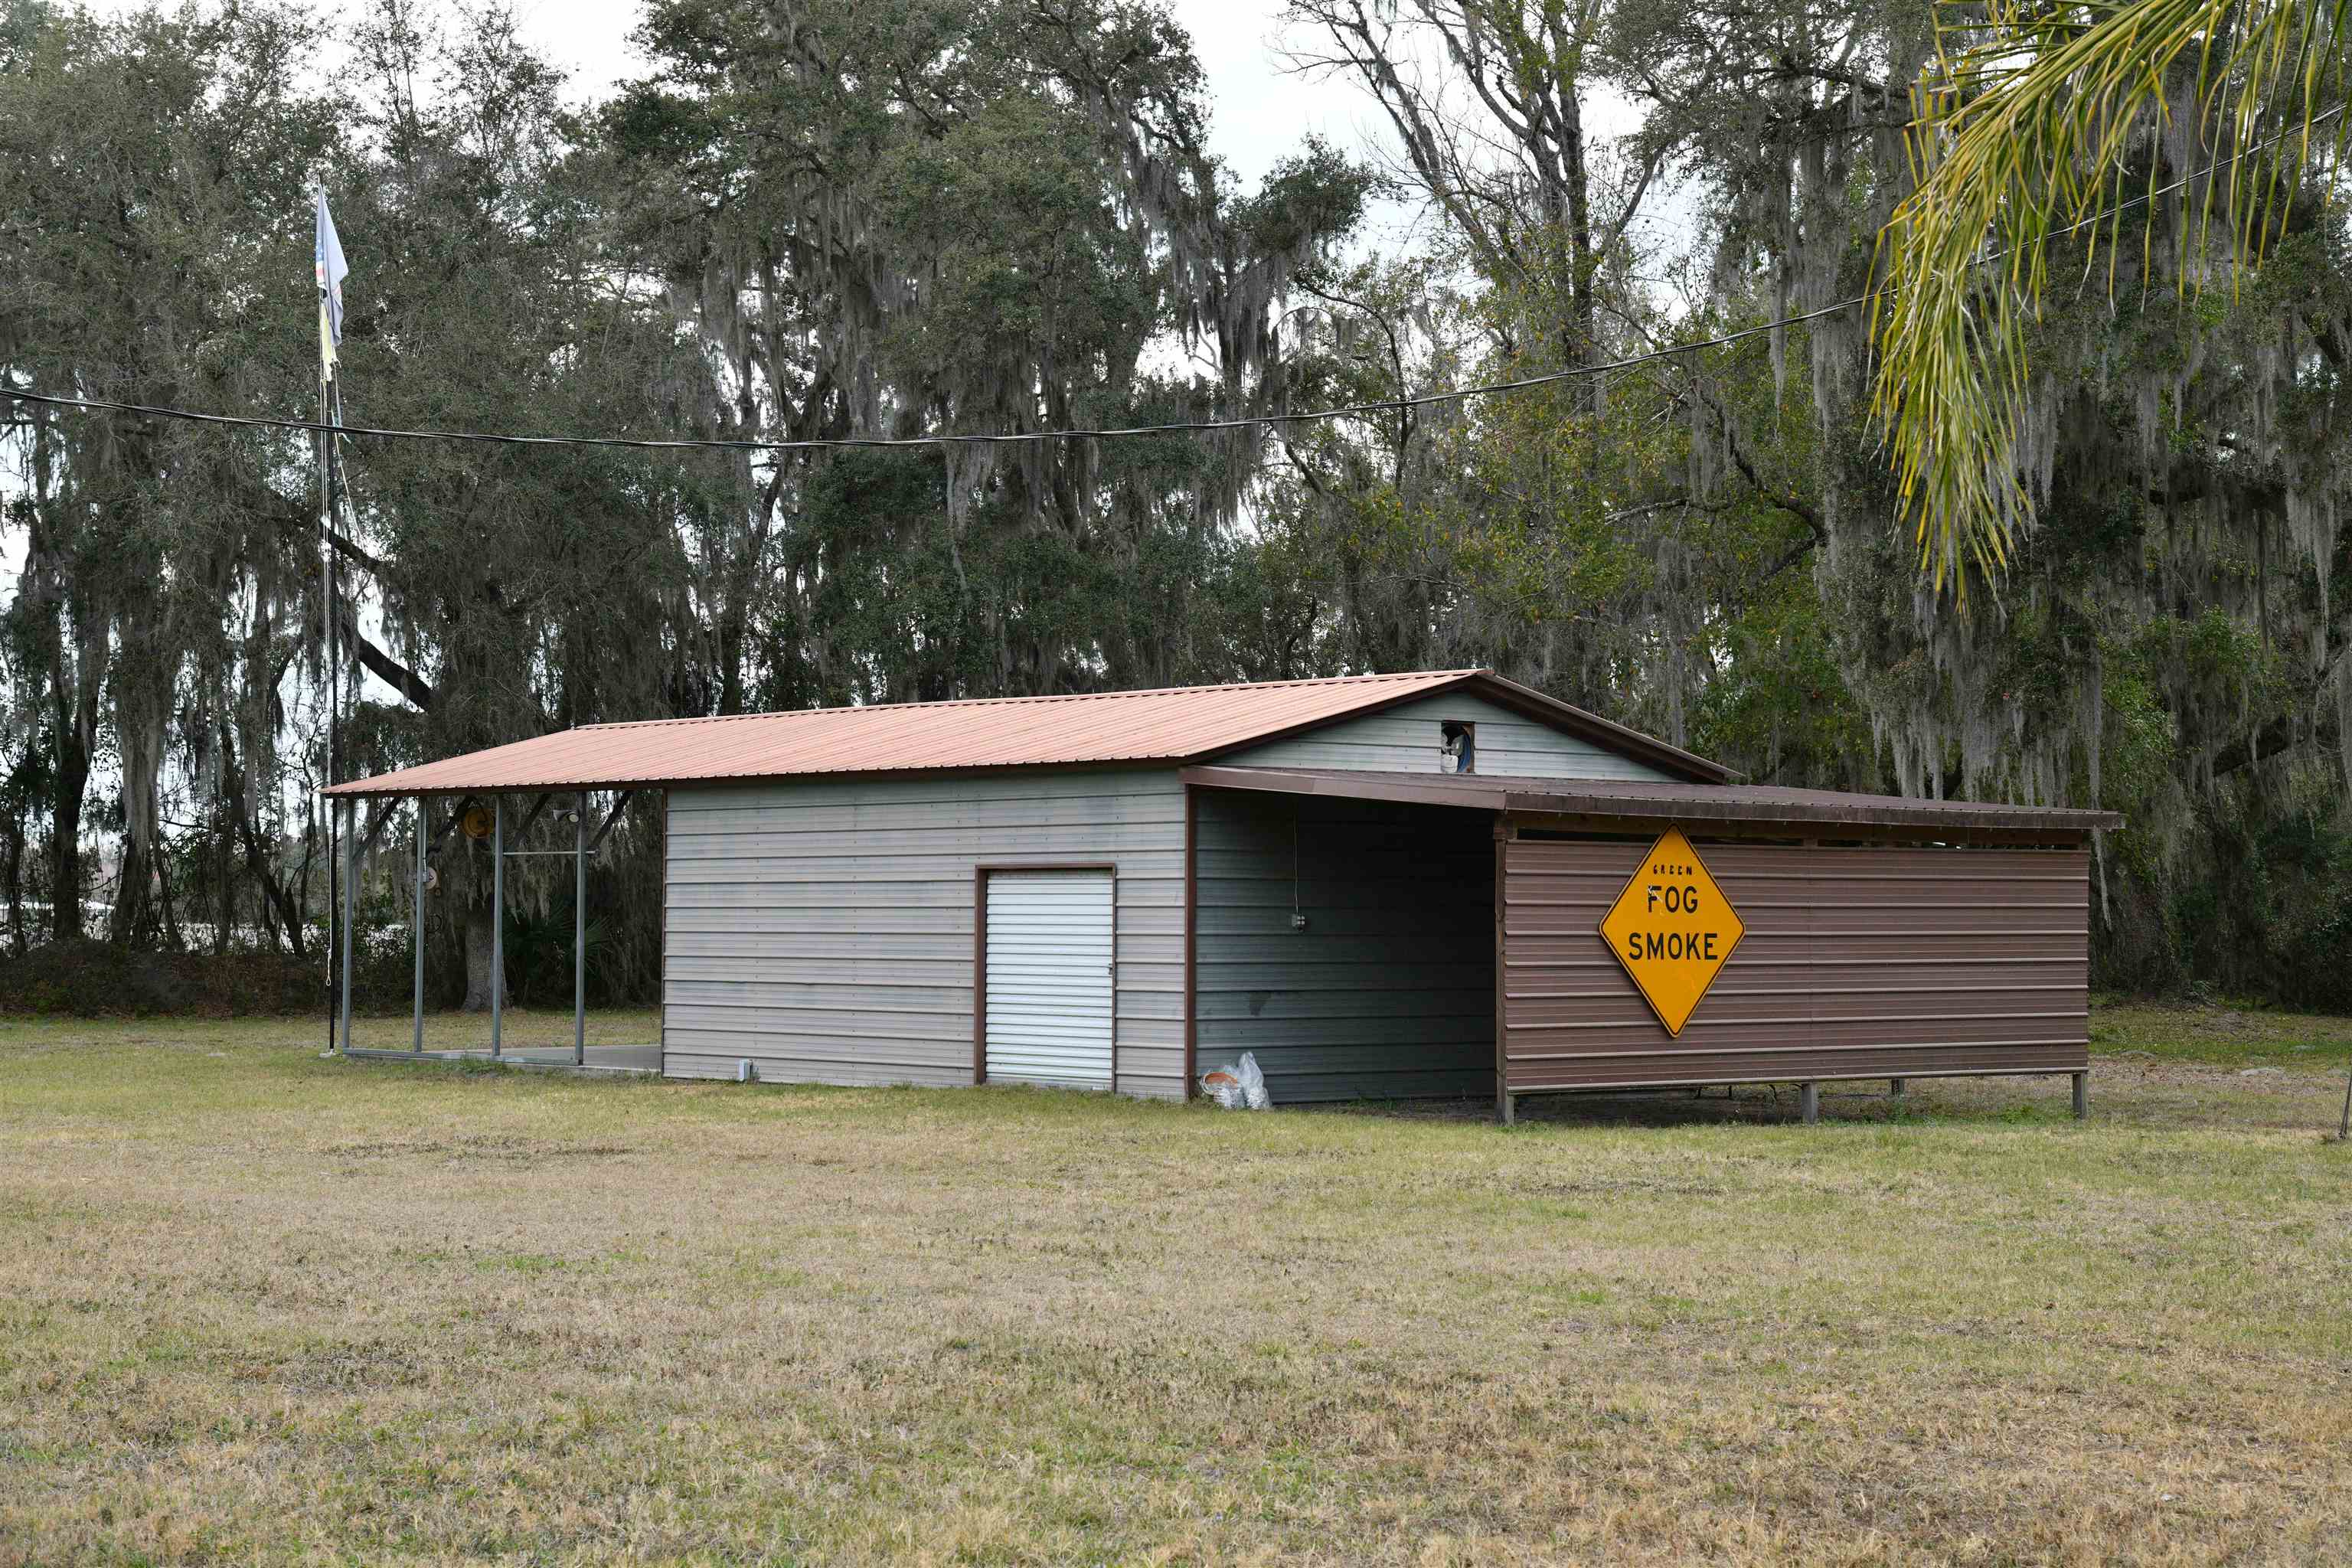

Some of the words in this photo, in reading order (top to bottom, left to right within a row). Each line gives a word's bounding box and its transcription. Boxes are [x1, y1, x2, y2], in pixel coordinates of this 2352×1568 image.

[1653, 864, 1692, 875] GREEN
[1648, 886, 1698, 913] FOG
[1628, 933, 1718, 960] SMOKE
